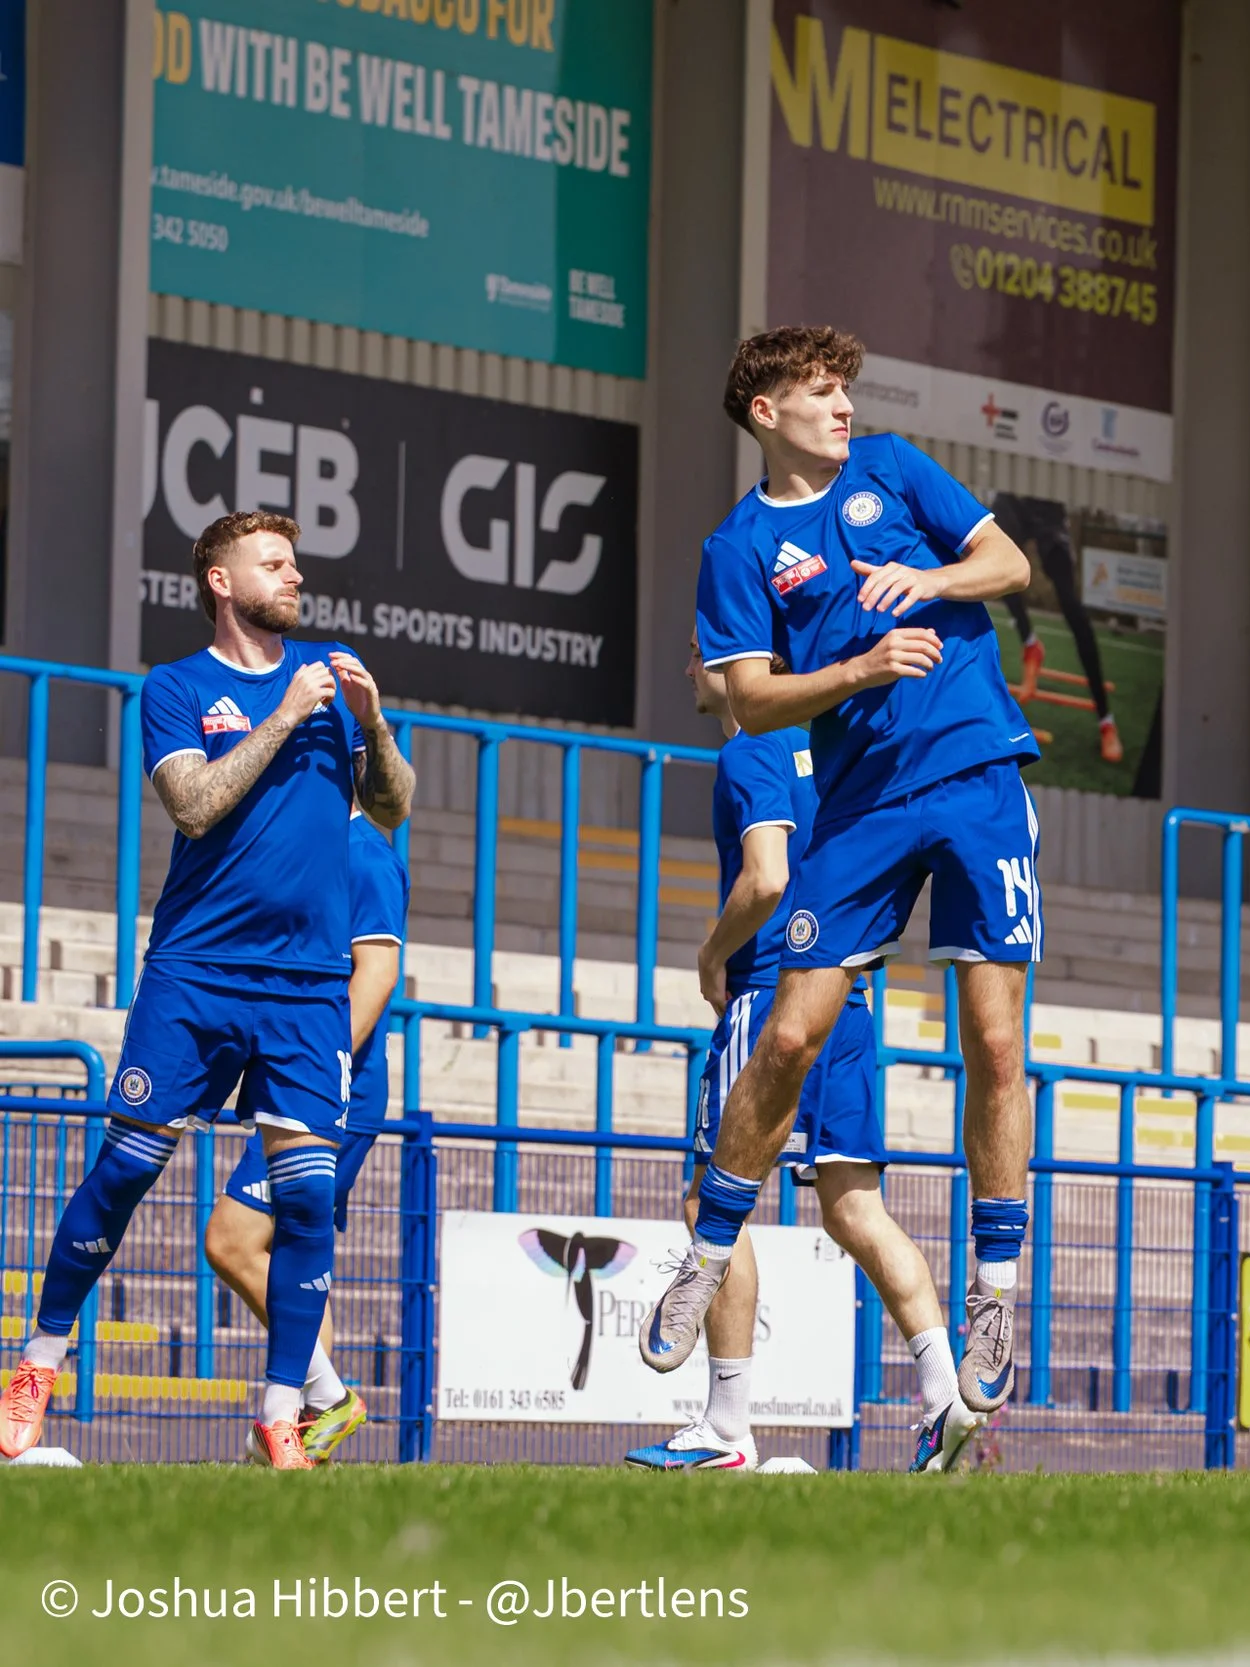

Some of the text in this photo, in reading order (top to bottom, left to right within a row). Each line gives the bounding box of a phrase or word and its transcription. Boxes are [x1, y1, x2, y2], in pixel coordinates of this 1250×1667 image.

[199, 18, 298, 108] WITH
[304, 41, 352, 119] BE
[358, 52, 452, 140] WELL
[458, 74, 631, 178] TAMESIDE
[885, 73, 1143, 190] ELECTRICAL
[153, 214, 229, 252] 342 5050
[974, 246, 1158, 326] 01204 388745
[145, 398, 607, 596] CFB GIS
[299, 591, 368, 635] OBAL
[373, 603, 475, 651] SPORTS
[479, 617, 604, 669] INDUSTRY
[996, 856, 1033, 917] 14
[444, 1388, 566, 1411] Tel: 0161 343 6585
